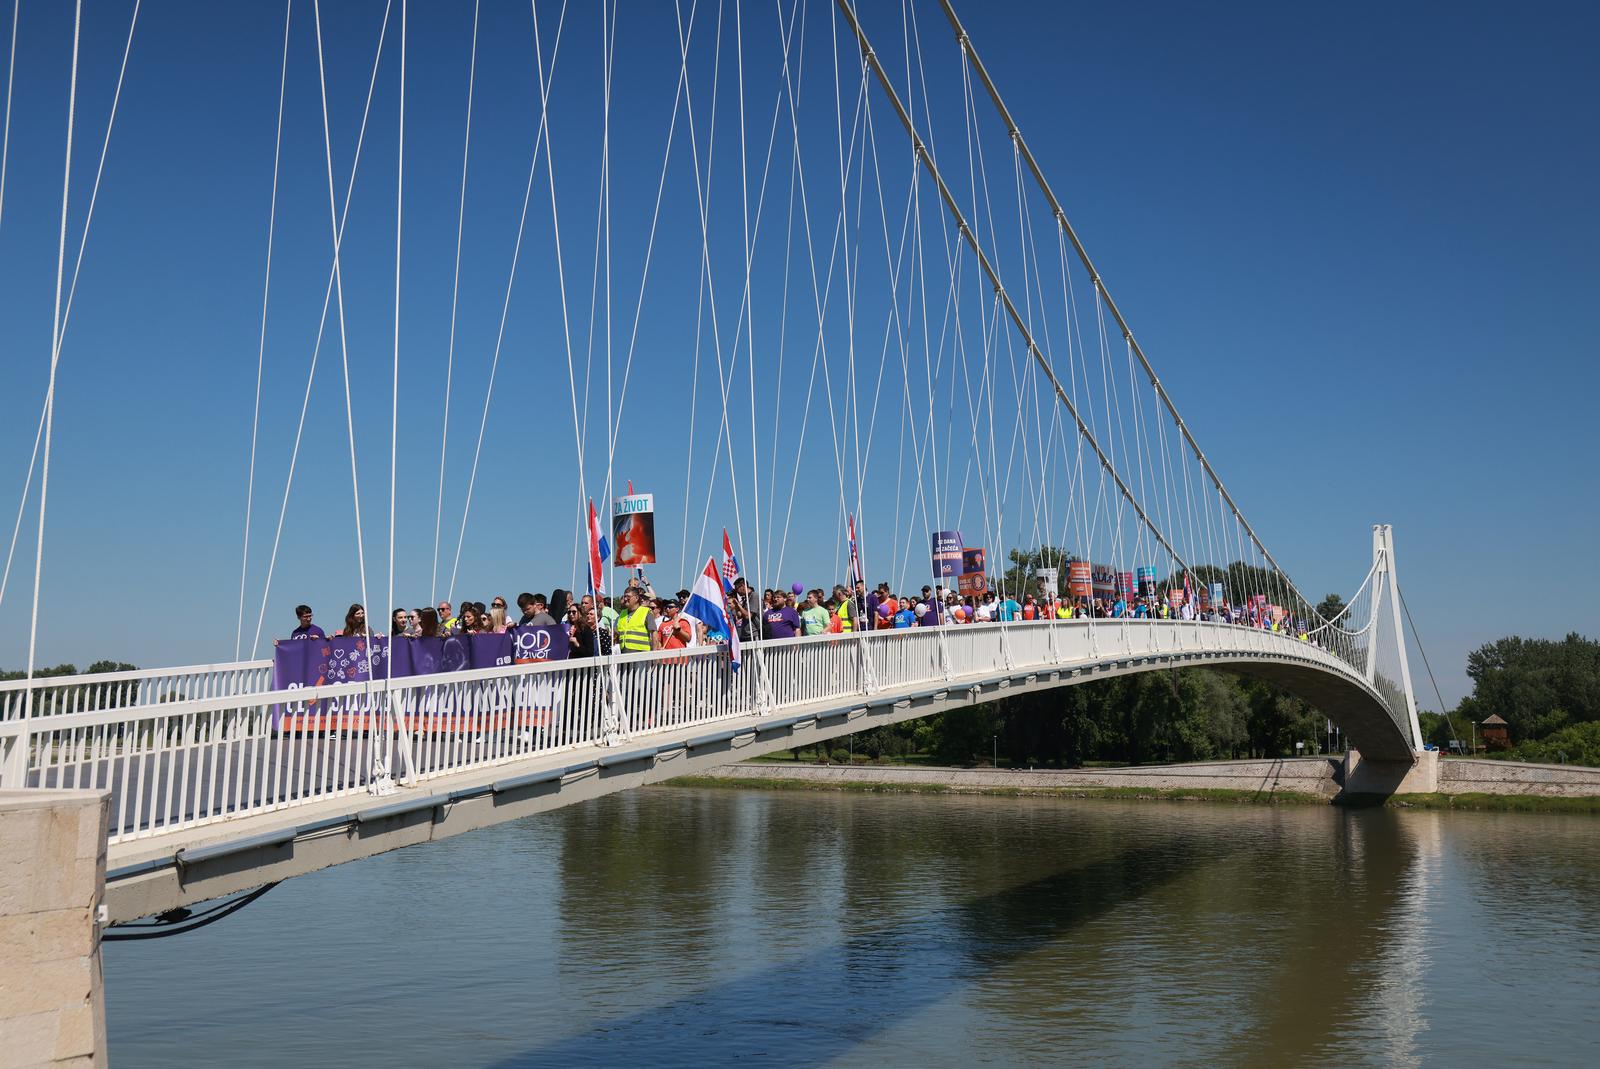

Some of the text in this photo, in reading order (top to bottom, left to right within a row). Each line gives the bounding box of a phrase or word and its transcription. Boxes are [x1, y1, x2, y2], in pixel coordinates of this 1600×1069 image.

[614, 498, 648, 515] ZA ŽIVOT
[521, 649, 551, 660] ŽIVOT
